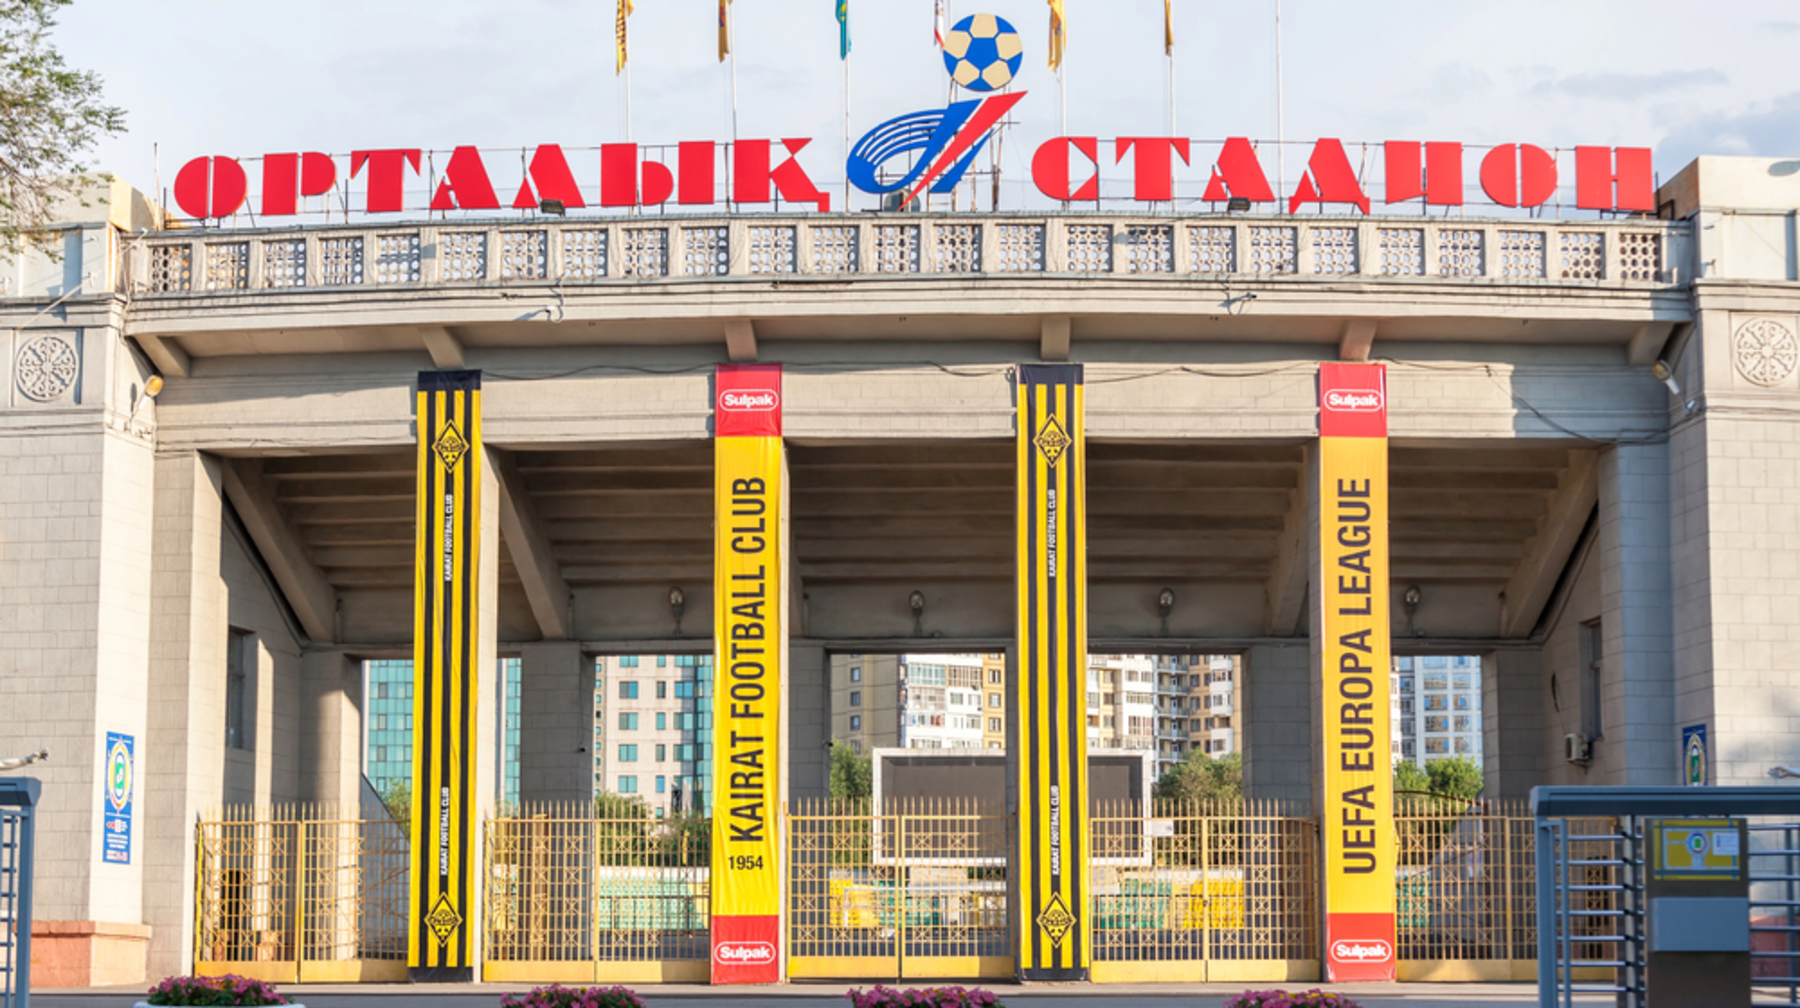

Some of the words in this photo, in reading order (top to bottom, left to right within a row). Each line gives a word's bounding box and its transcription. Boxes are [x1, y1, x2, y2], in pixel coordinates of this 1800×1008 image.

[174, 138, 830, 218] ОРТАЛЫҚ
[1031, 136, 1652, 215] СТАДИОН
[724, 394, 773, 409] Sulpak
[1329, 393, 1378, 409] Sulpak
[444, 494, 453, 514] CLUB
[731, 478, 765, 553] CLUB
[1047, 489, 1056, 509] CLUB
[444, 515, 453, 553] FOOTBALL
[1047, 510, 1056, 548] FOOTBALL
[1338, 479, 1371, 614] LEAGUE
[731, 565, 765, 718] FOOTBALL
[1340, 629, 1373, 770] EUROPA
[441, 786, 450, 807] CLUB
[730, 731, 764, 841] KAIRAT
[1050, 785, 1059, 806] CLUB
[440, 808, 449, 847] FOOTBALL
[1050, 807, 1059, 846] FOOTBALL
[1343, 785, 1375, 873] UEFA
[728, 855, 764, 871] 1954
[719, 945, 770, 962] Sulpak
[1336, 944, 1387, 960] Sulpak
